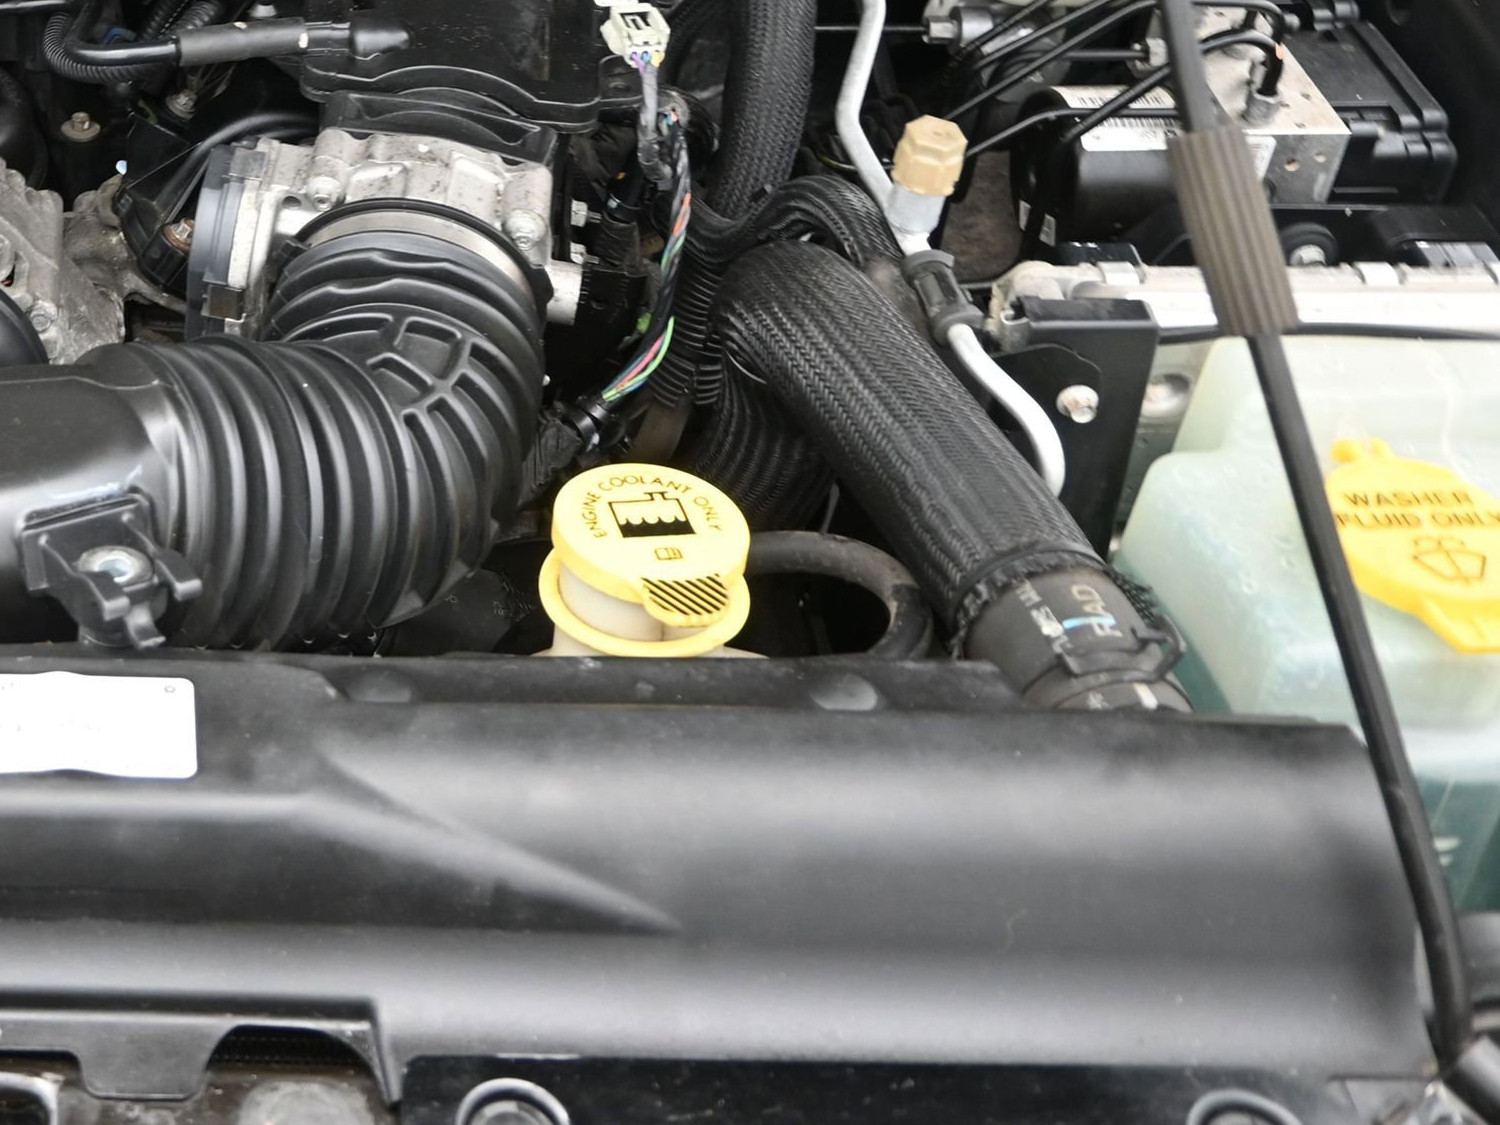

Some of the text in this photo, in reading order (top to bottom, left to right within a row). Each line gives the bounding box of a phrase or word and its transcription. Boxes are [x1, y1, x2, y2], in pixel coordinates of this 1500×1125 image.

[582, 475, 722, 538] ENGINE COOLANT ONLY
[1343, 491, 1474, 507] WASHER
[1335, 513, 1421, 528] FLUID
